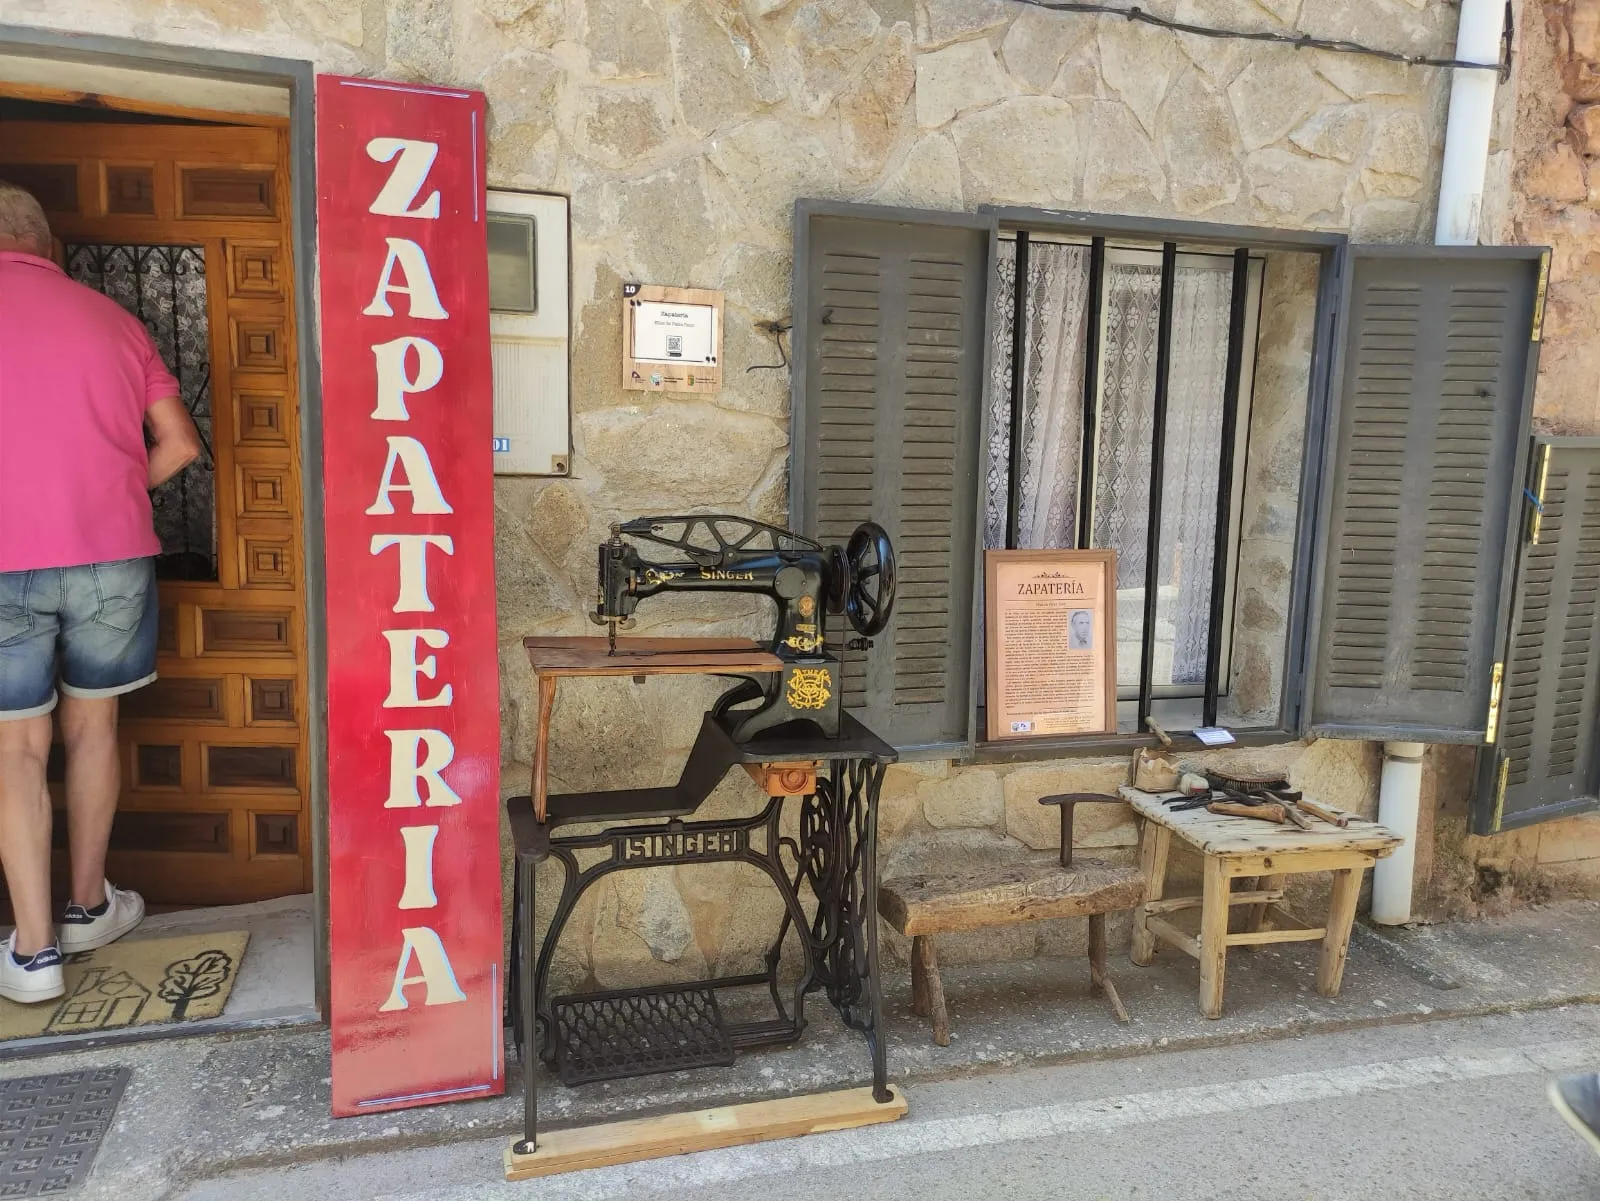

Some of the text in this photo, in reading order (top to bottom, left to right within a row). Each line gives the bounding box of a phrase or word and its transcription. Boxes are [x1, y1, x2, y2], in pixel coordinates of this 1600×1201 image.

[625, 286, 636, 294] 10
[362, 137, 467, 1012] ZAPATERIA
[701, 570, 755, 581] SINGER
[1017, 580, 1084, 595] ZAPATERÍA
[627, 829, 736, 859] SINGER
